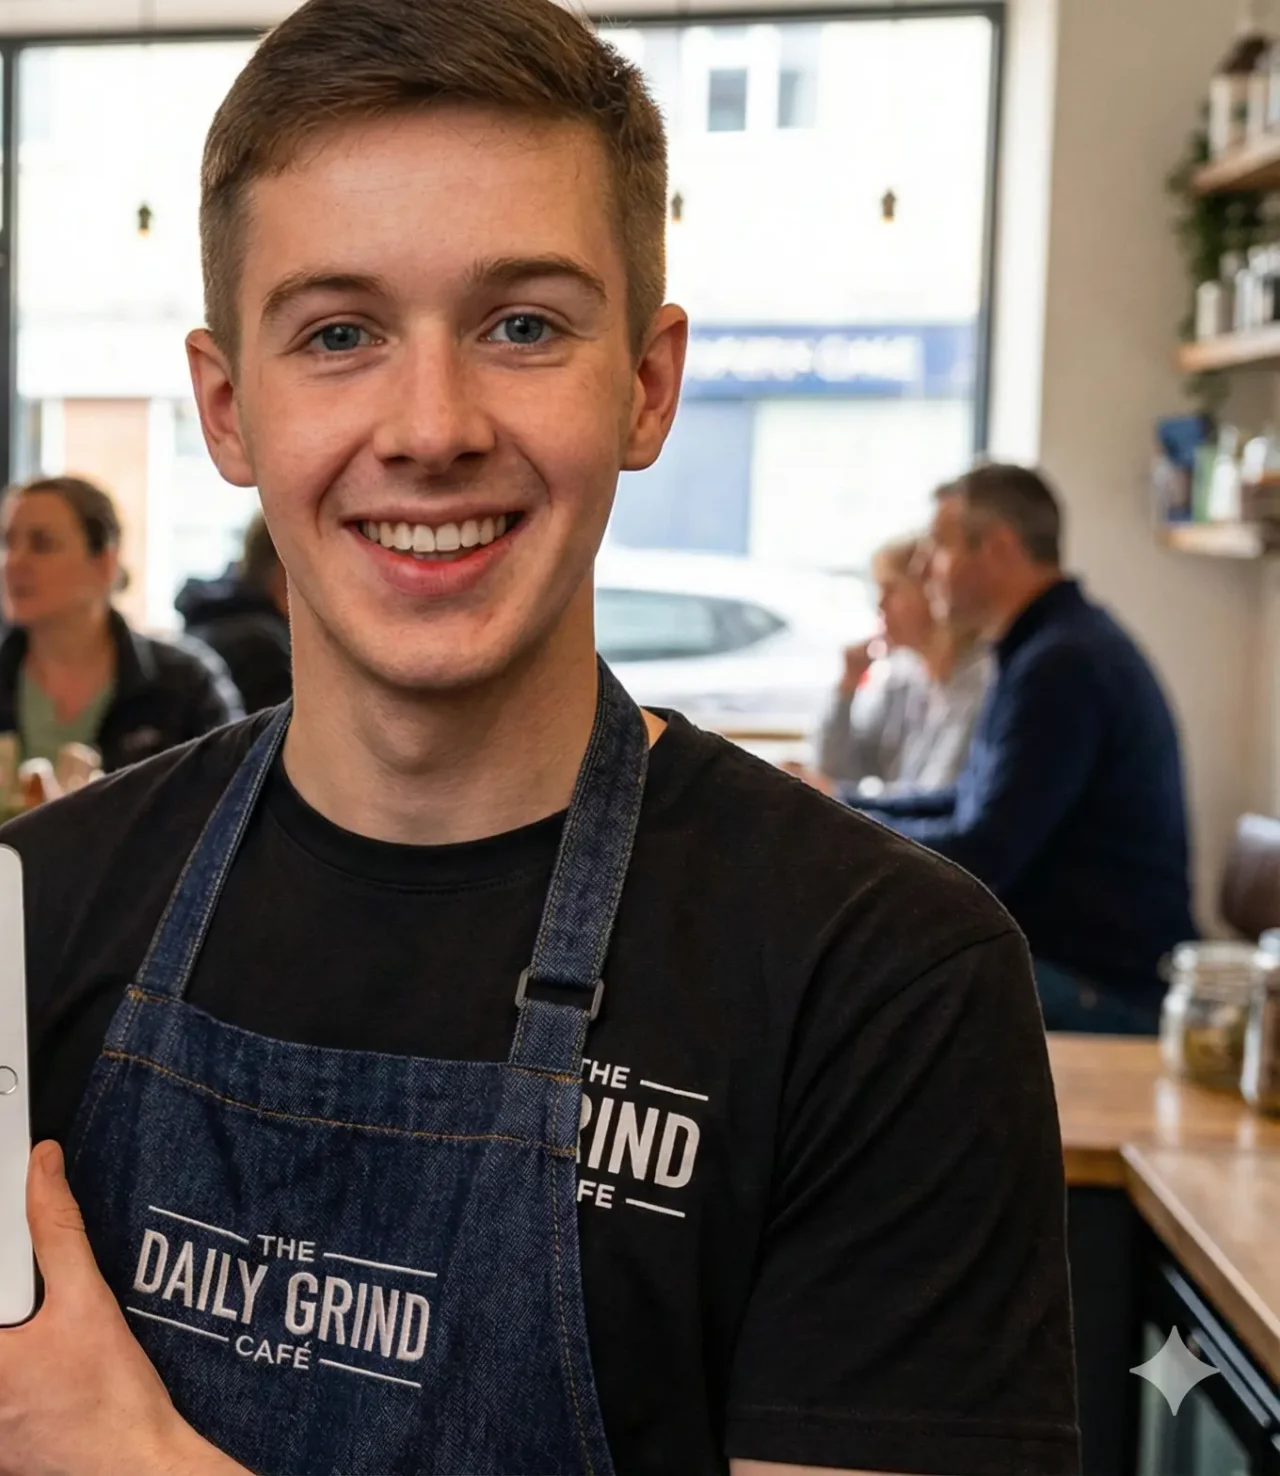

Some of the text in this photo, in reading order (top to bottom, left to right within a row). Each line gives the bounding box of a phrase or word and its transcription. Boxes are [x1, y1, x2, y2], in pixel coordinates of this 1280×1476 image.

[257, 1234, 316, 1262] THE
[132, 1228, 430, 1362] DAILY GRIND
[235, 1335, 312, 1370] CAFÉ
